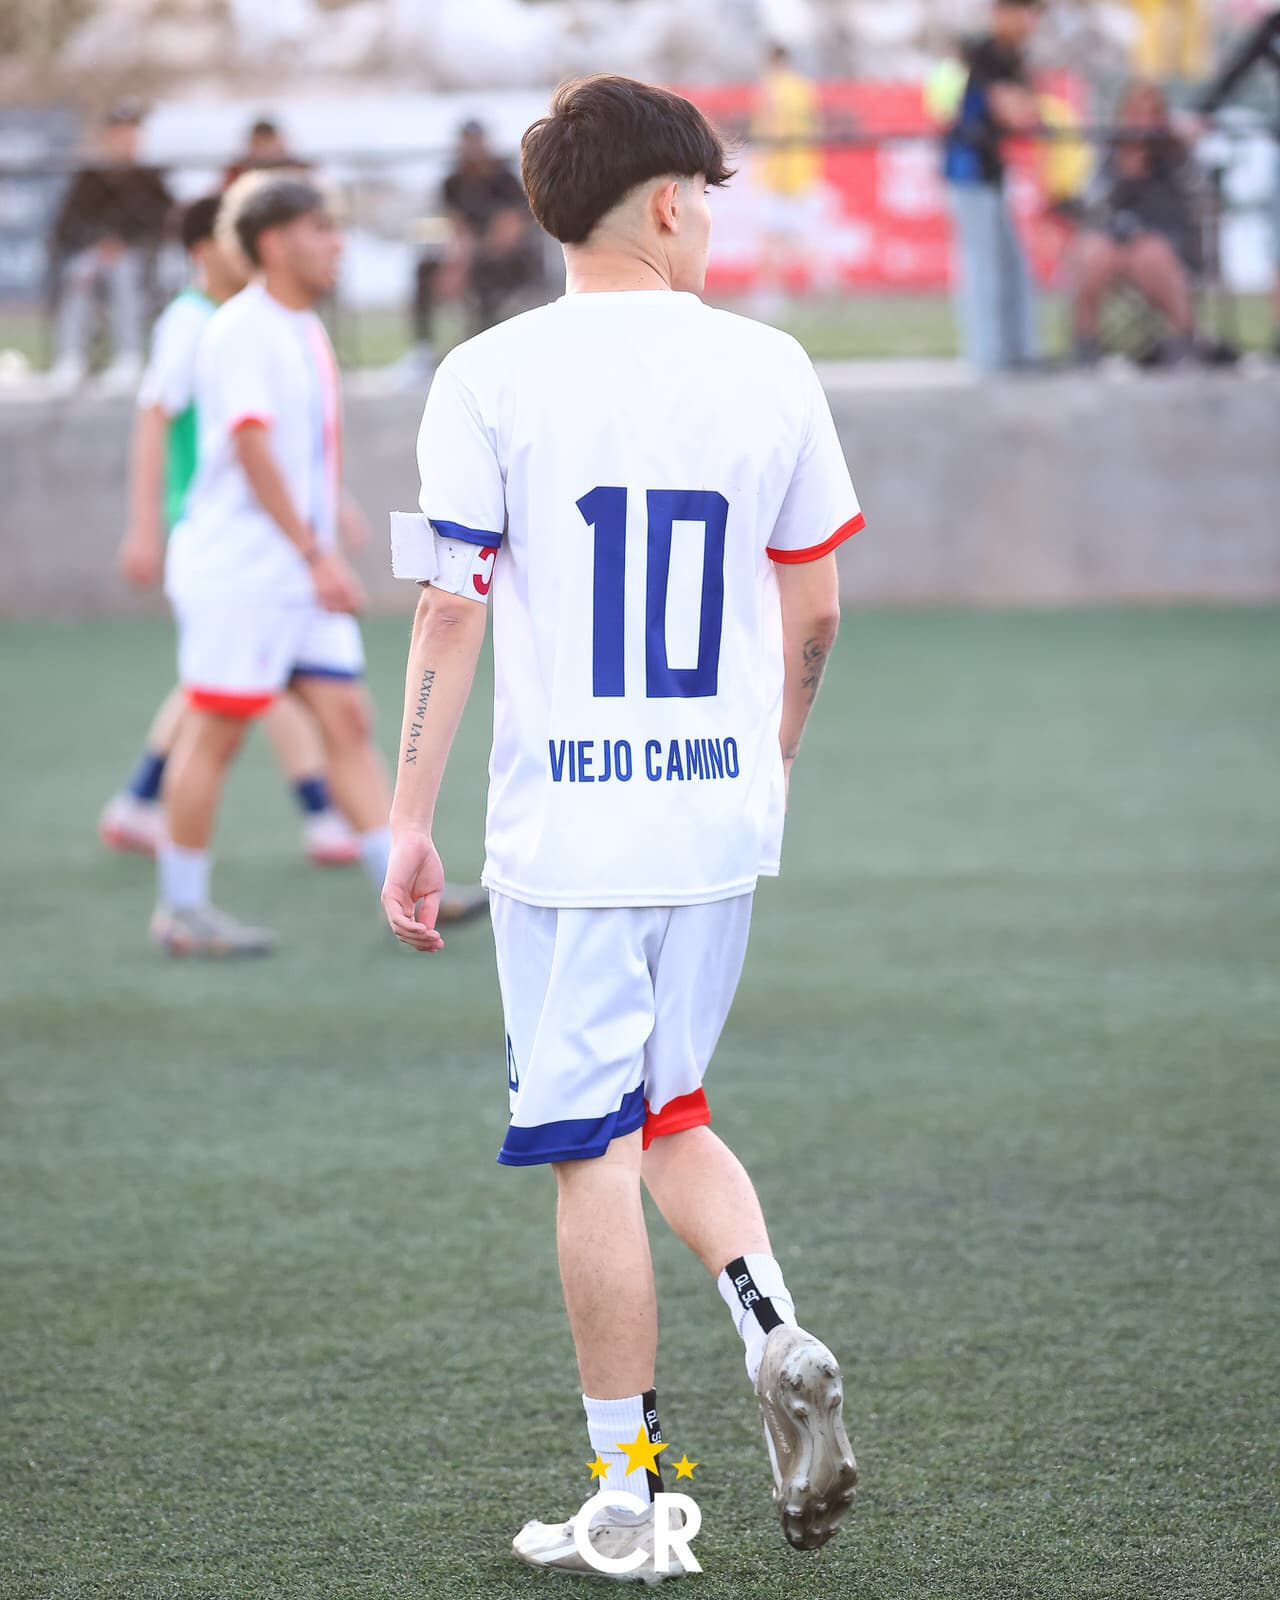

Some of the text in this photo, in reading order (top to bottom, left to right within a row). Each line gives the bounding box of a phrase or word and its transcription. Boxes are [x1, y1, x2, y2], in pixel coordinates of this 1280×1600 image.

[575, 486, 730, 698] 10
[405, 669, 436, 765] XV-VI MMXXI
[548, 736, 740, 783] VIEJO CAMINO
